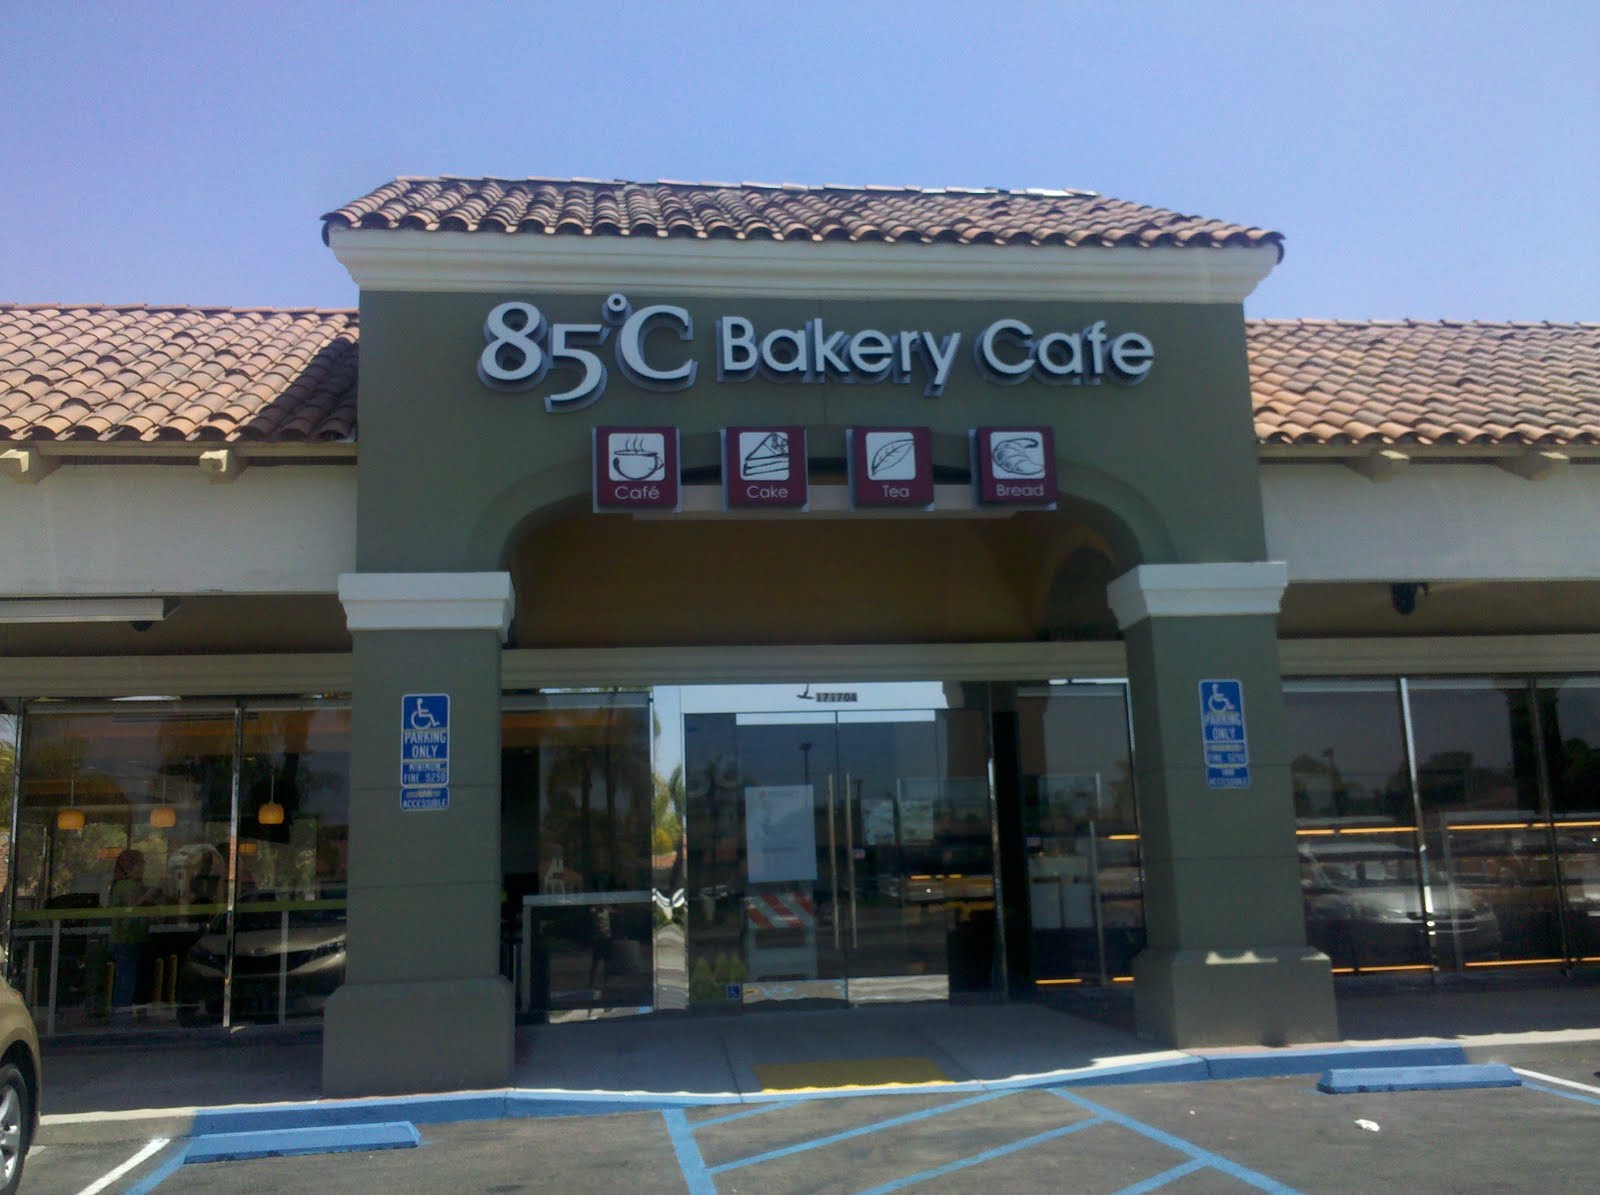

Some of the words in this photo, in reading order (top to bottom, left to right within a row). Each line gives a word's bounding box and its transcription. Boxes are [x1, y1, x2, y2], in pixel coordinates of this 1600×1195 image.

[721, 315, 962, 386] Bakery
[980, 318, 1155, 375] Cafe
[614, 484, 660, 500] Café
[746, 485, 789, 499] Cake
[882, 485, 910, 498] Tea
[995, 484, 1045, 497] Bread
[404, 731, 446, 744] PARKING
[412, 745, 439, 758] ONLY
